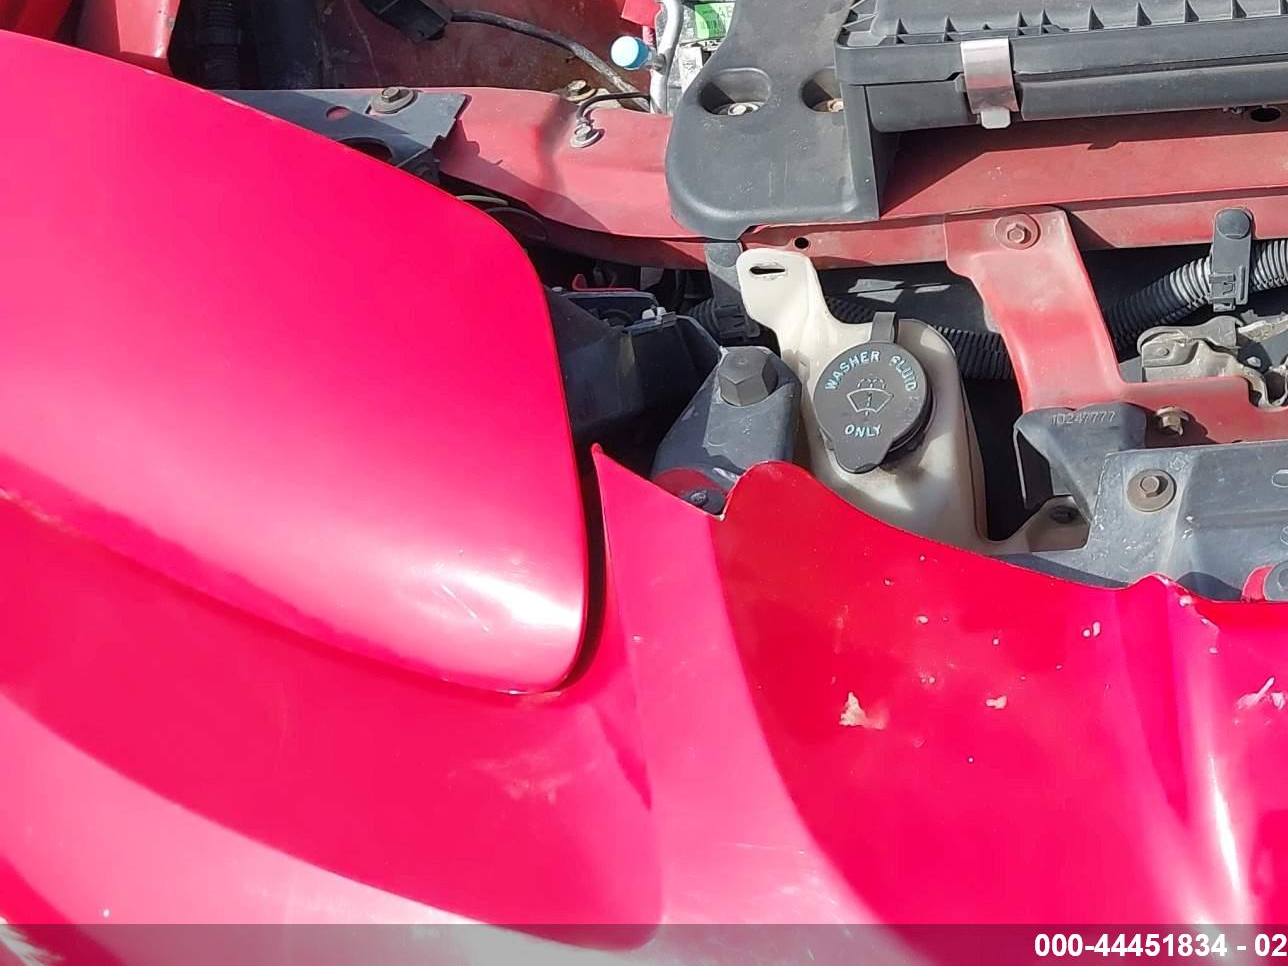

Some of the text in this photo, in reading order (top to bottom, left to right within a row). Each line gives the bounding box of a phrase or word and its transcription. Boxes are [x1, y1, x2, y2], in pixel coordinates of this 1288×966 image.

[825, 350, 919, 392] WASHER FLUID
[1051, 410, 1116, 426] 10247777
[844, 424, 882, 438] ONLY
